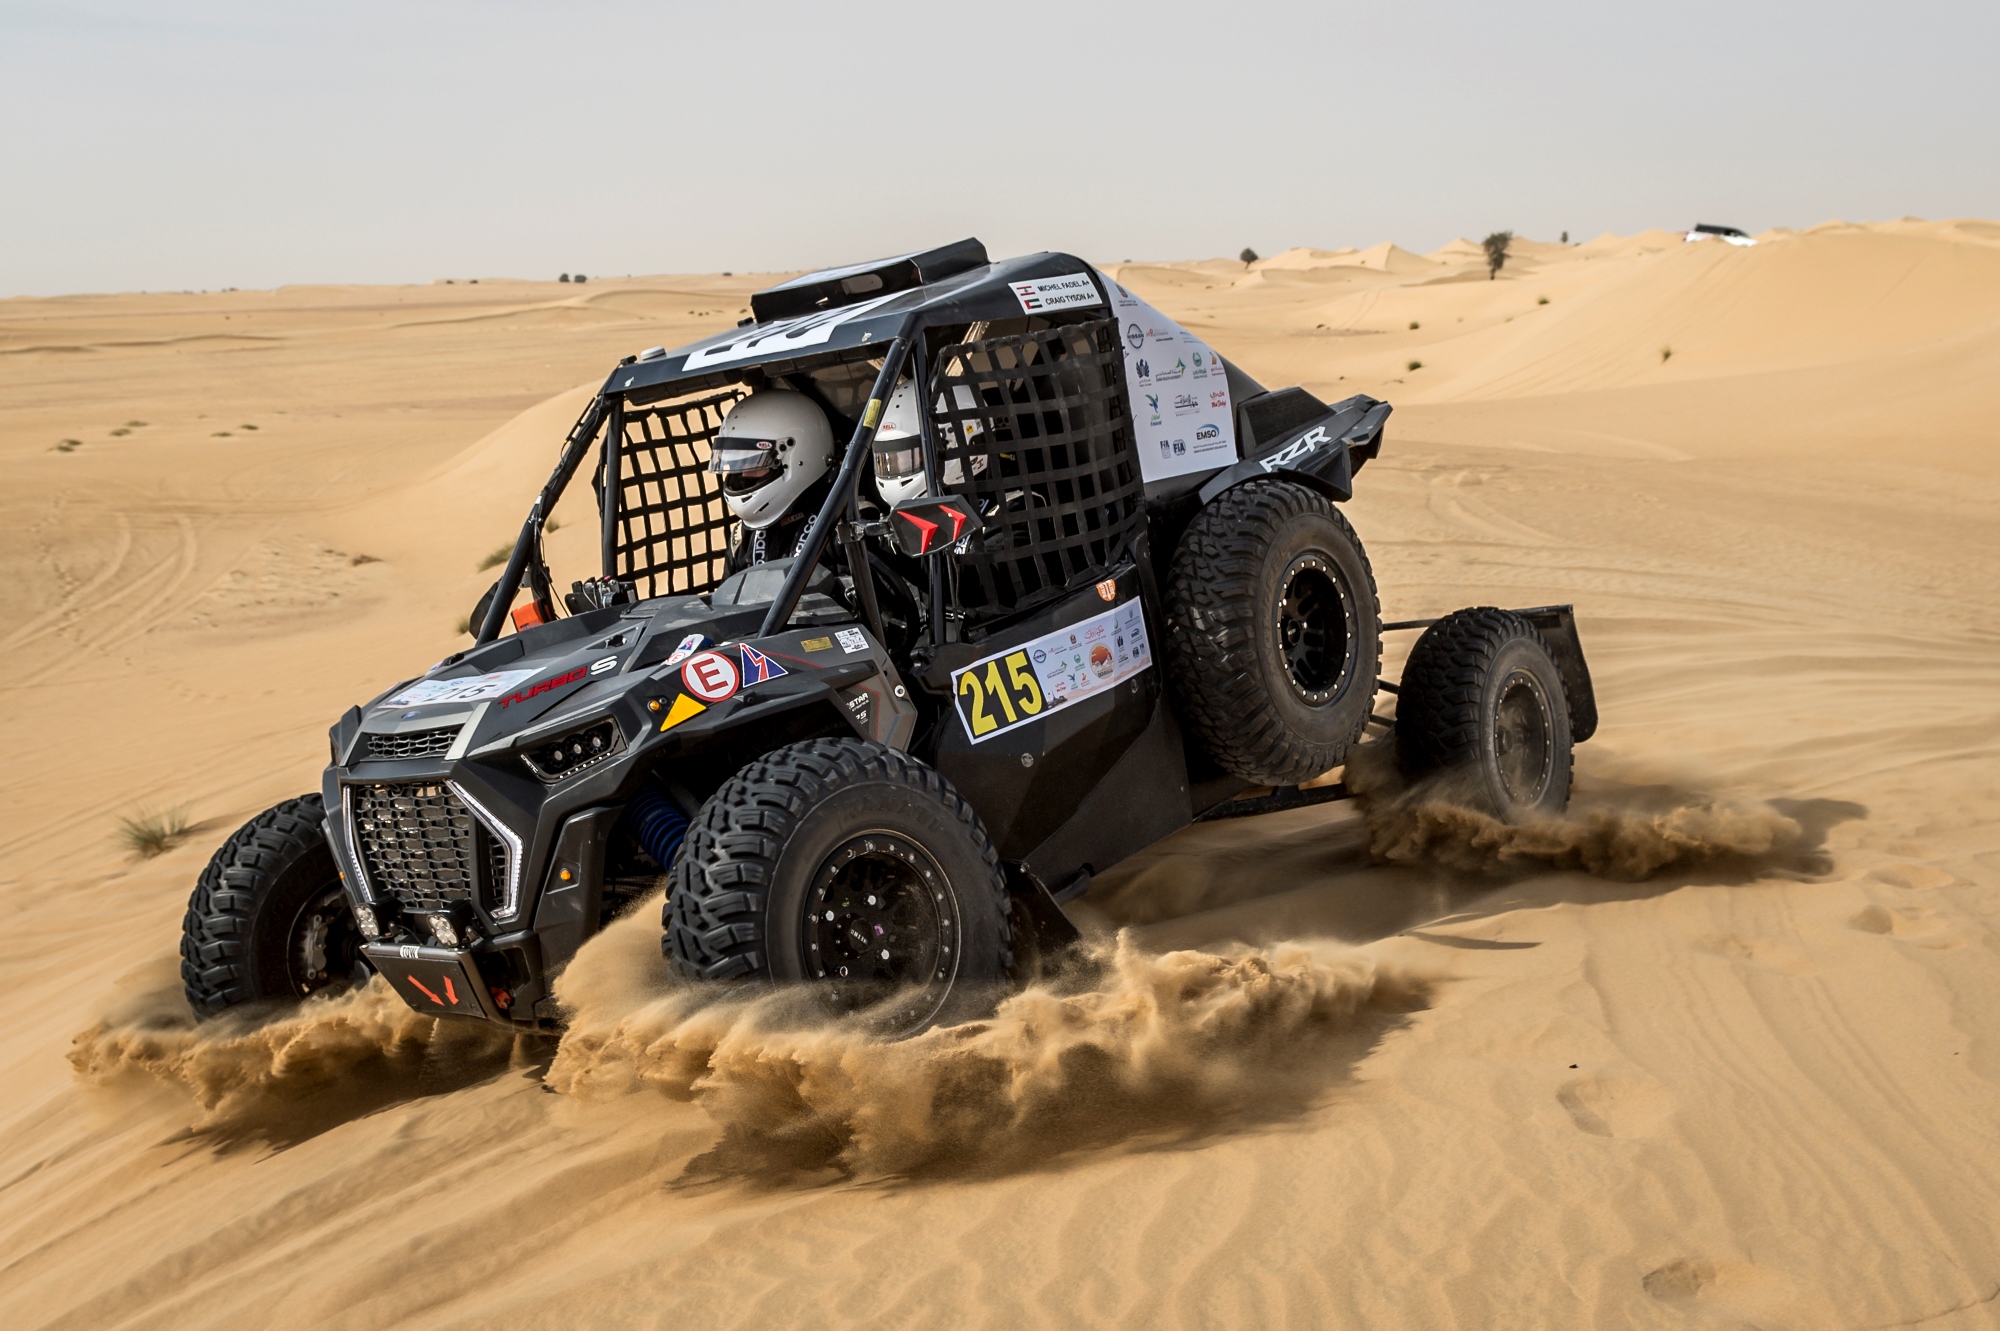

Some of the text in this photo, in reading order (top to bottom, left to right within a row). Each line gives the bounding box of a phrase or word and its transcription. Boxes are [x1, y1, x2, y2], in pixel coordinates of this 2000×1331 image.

[1037, 279, 1090, 292] MICHEL FADEL A+
[1045, 292, 1095, 305] CRAIG TYSON A+
[1196, 429, 1217, 440] EMSO
[1173, 442, 1186, 453] FIA
[1259, 425, 1332, 473] RZR
[497, 655, 618, 709] TURBO S
[691, 657, 729, 693] E
[959, 651, 1042, 737] 215
